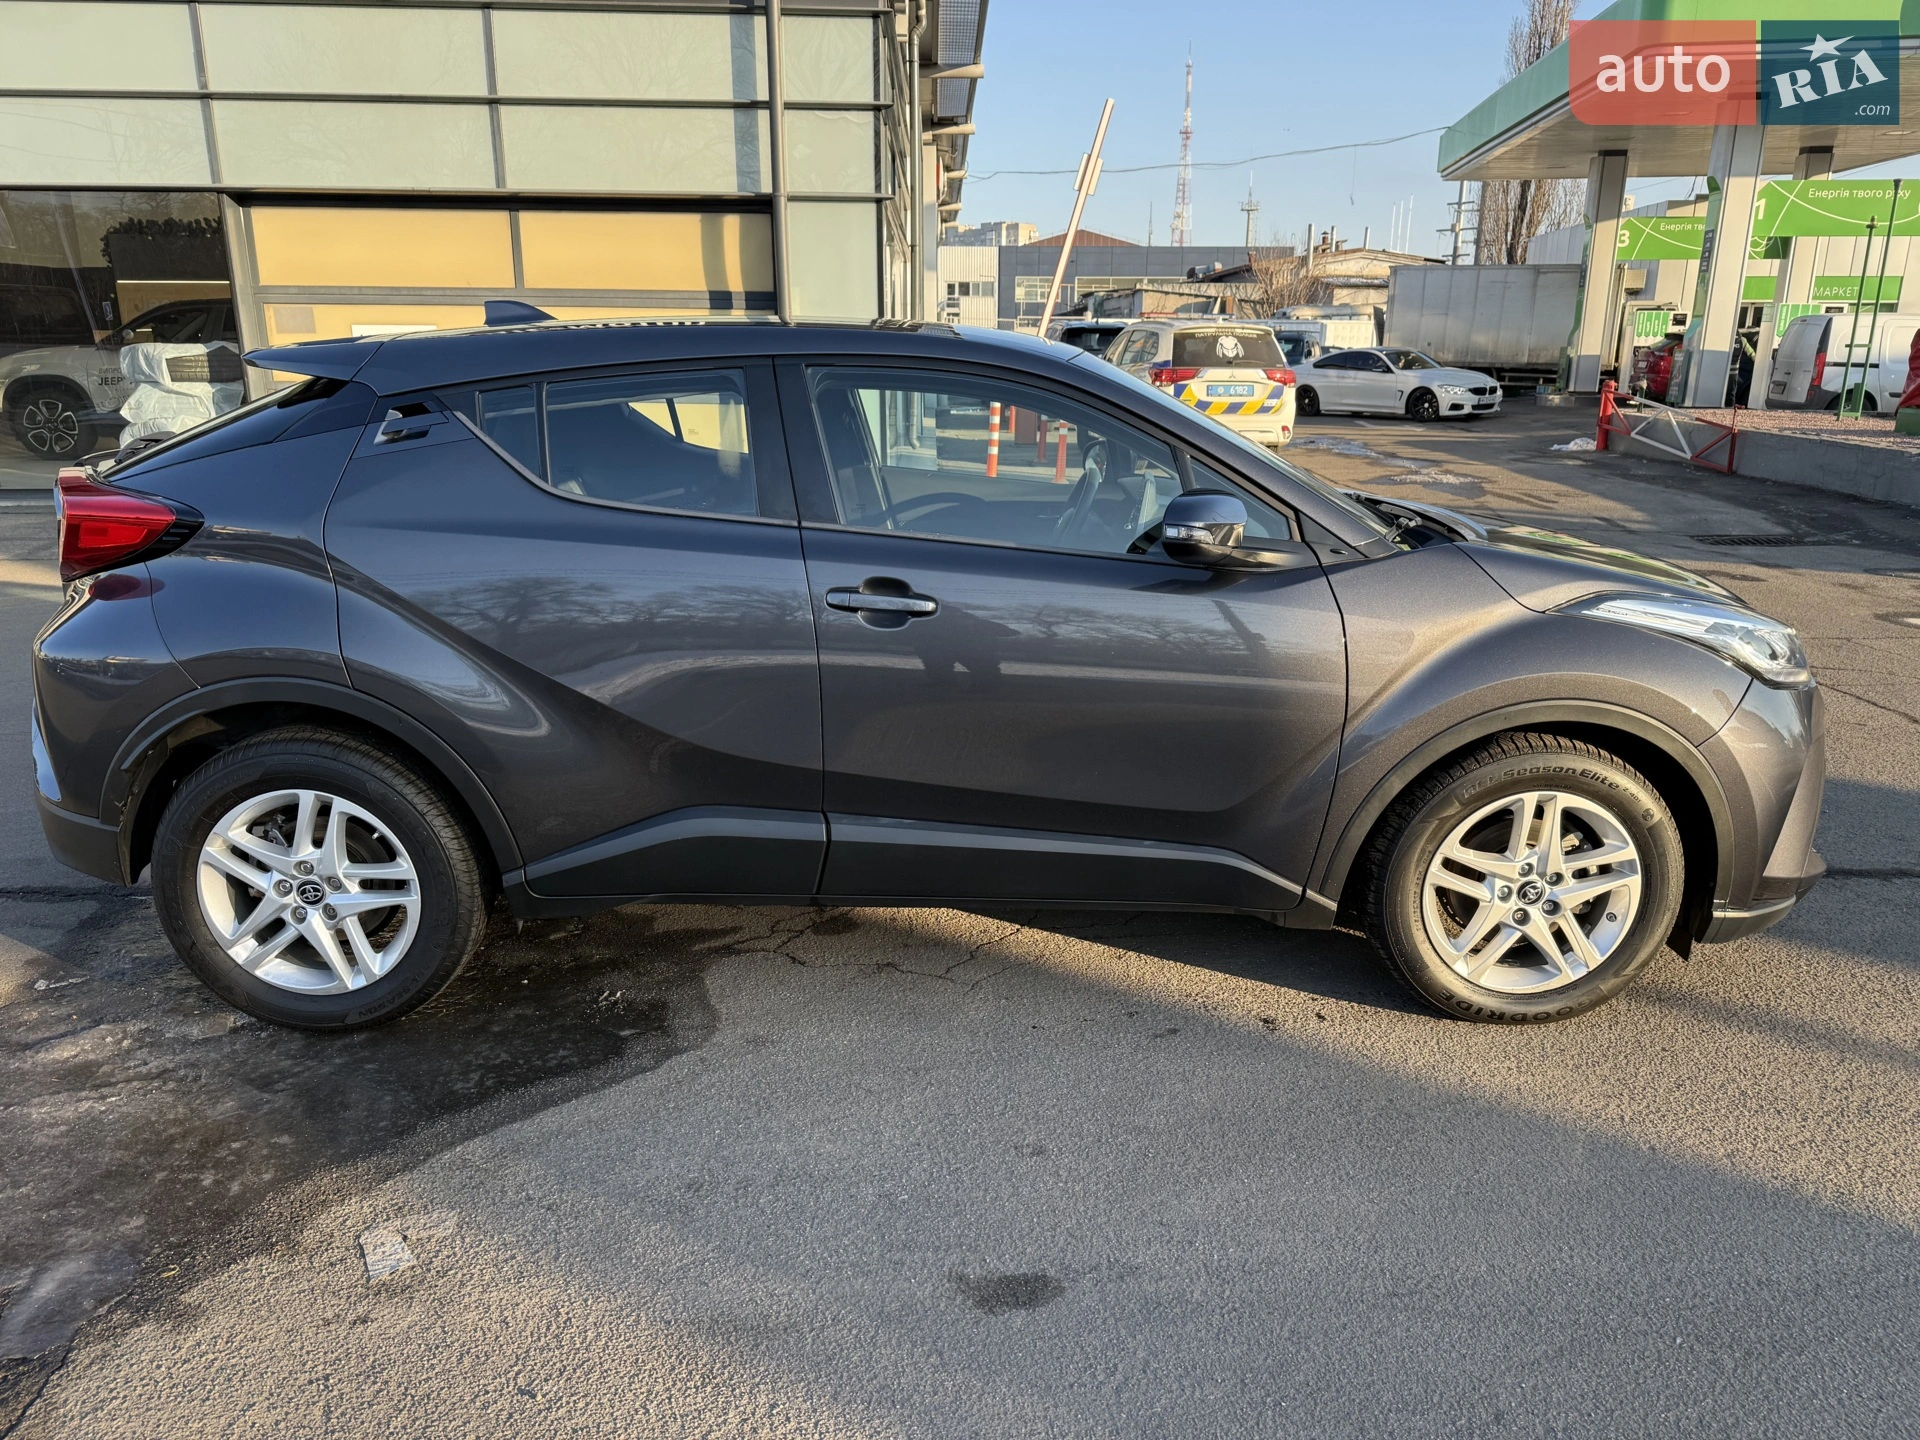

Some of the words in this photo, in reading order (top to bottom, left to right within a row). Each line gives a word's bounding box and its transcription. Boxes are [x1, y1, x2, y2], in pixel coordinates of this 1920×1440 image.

[1808, 188, 1849, 199] Енергія
[1852, 190, 1883, 198] твого
[1660, 222, 1692, 232] Енергія
[1617, 229, 1630, 247] 3
[1813, 286, 1860, 297] МАРКЕТ
[1230, 386, 1248, 394] 6182
[1578, 768, 1620, 791] Elite
[1437, 989, 1594, 1023] GOODRIDE
